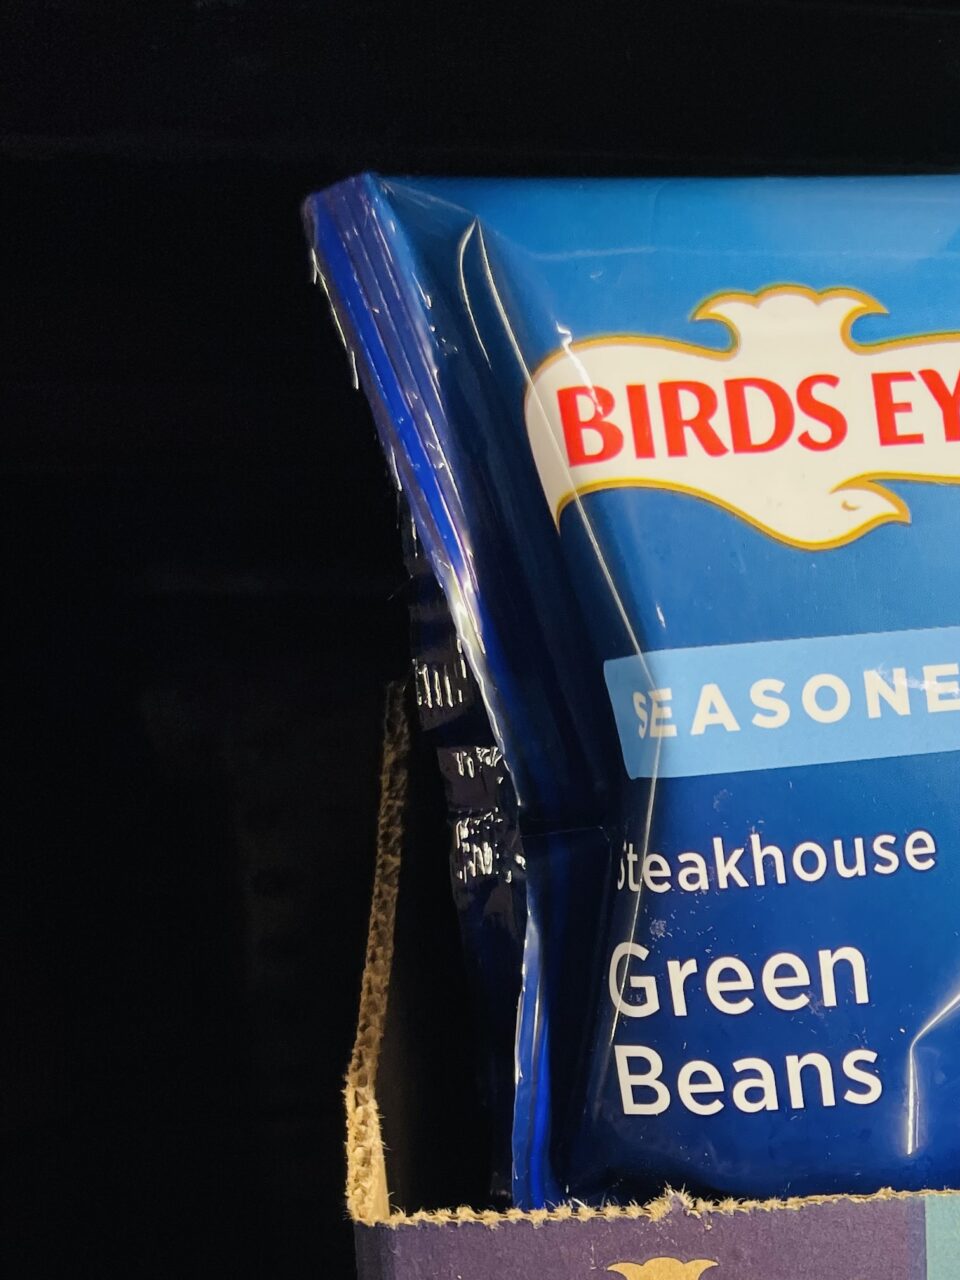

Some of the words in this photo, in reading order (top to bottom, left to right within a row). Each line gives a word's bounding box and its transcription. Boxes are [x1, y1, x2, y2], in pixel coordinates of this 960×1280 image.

[556, 374, 848, 468] BIRDS
[608, 941, 869, 1018] Green
[614, 1044, 883, 1117] Beans
